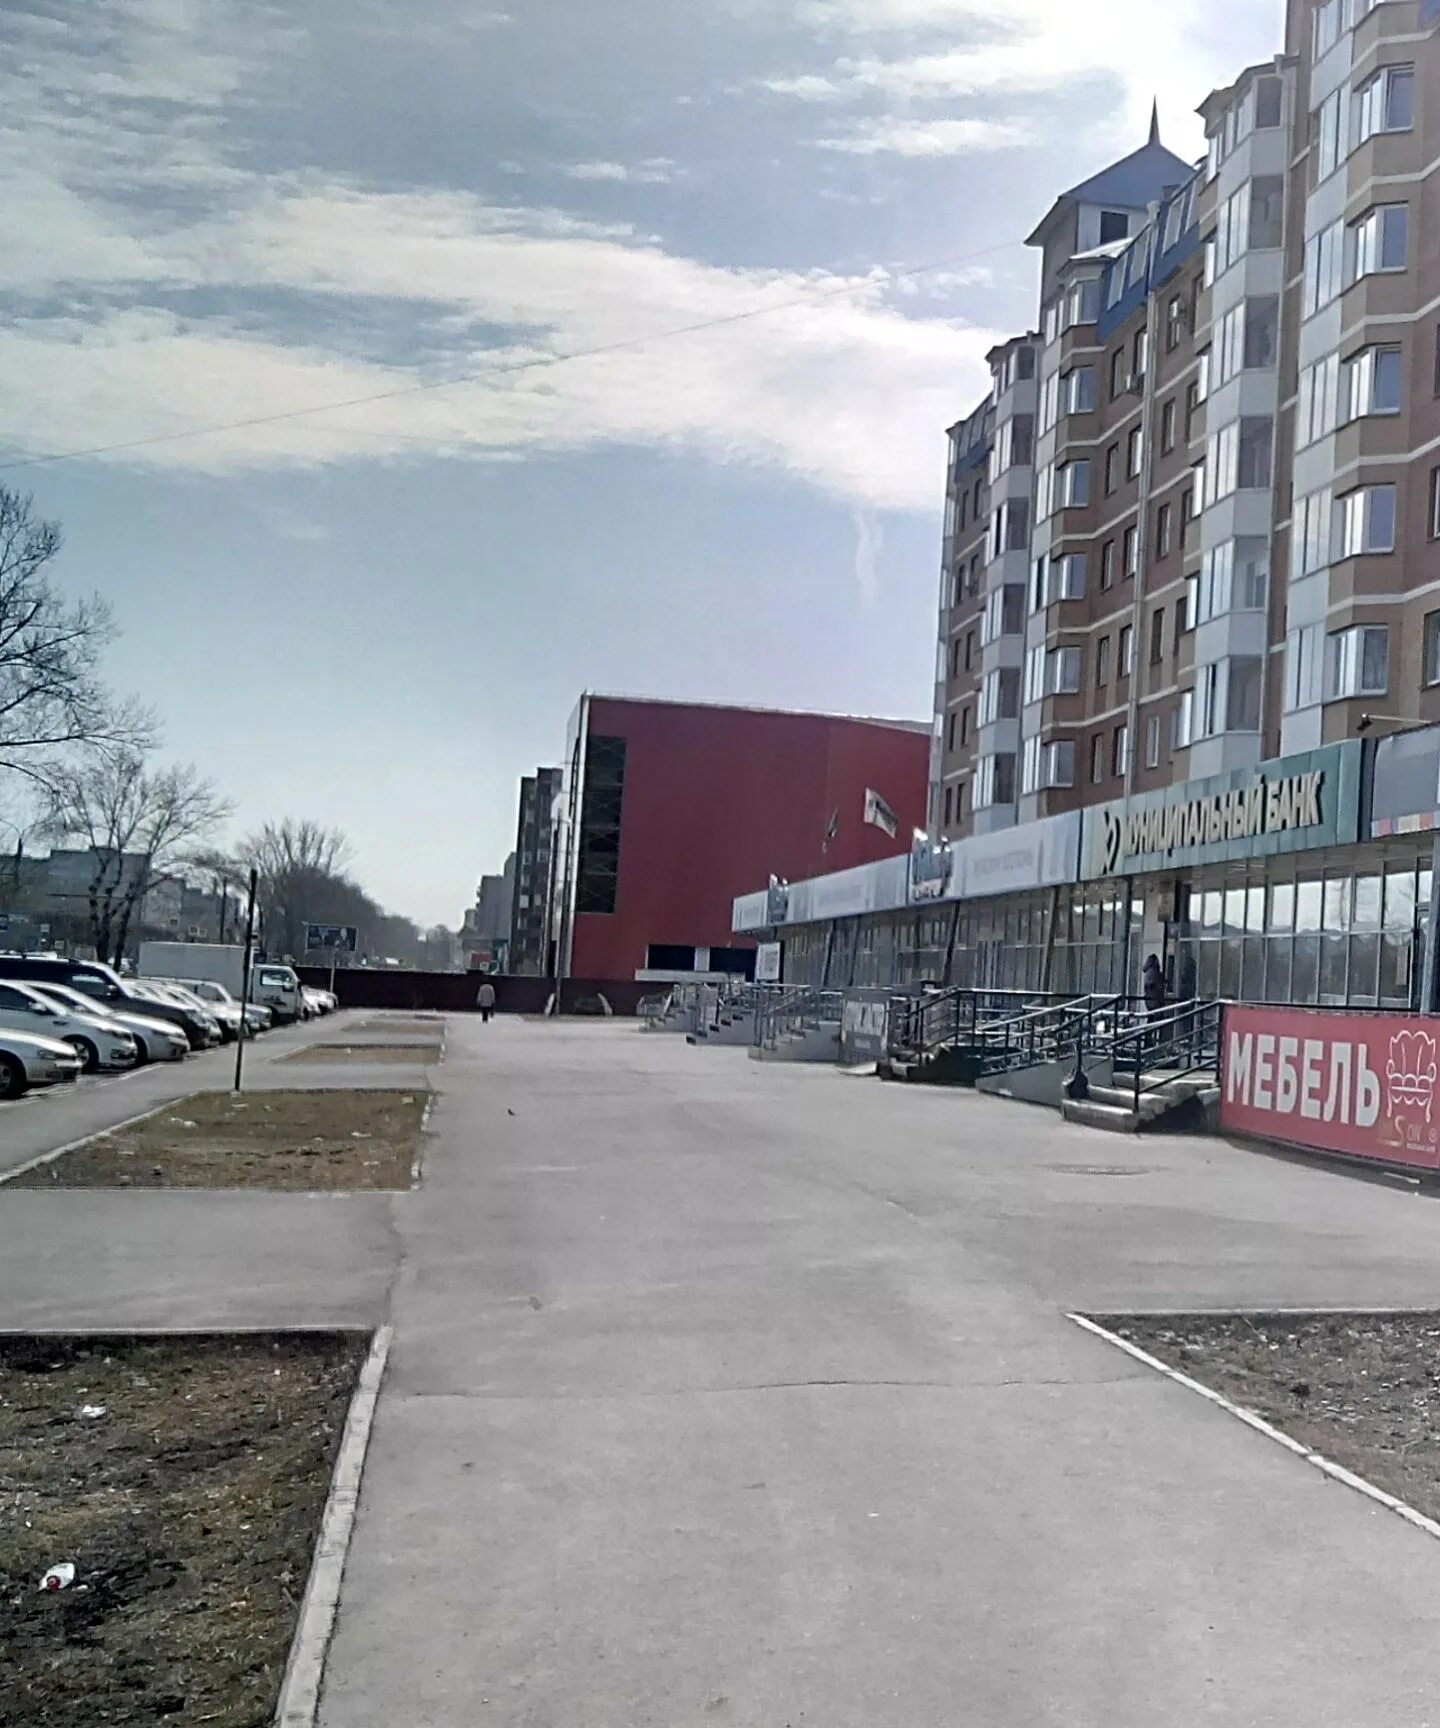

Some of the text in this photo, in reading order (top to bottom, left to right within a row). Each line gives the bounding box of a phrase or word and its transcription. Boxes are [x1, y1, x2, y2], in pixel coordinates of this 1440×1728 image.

[1122, 771, 1325, 857] МУНИЦИПАЛЬНЫЙ БАНК
[1227, 1032, 1381, 1127] МЕБЕЛЬ
